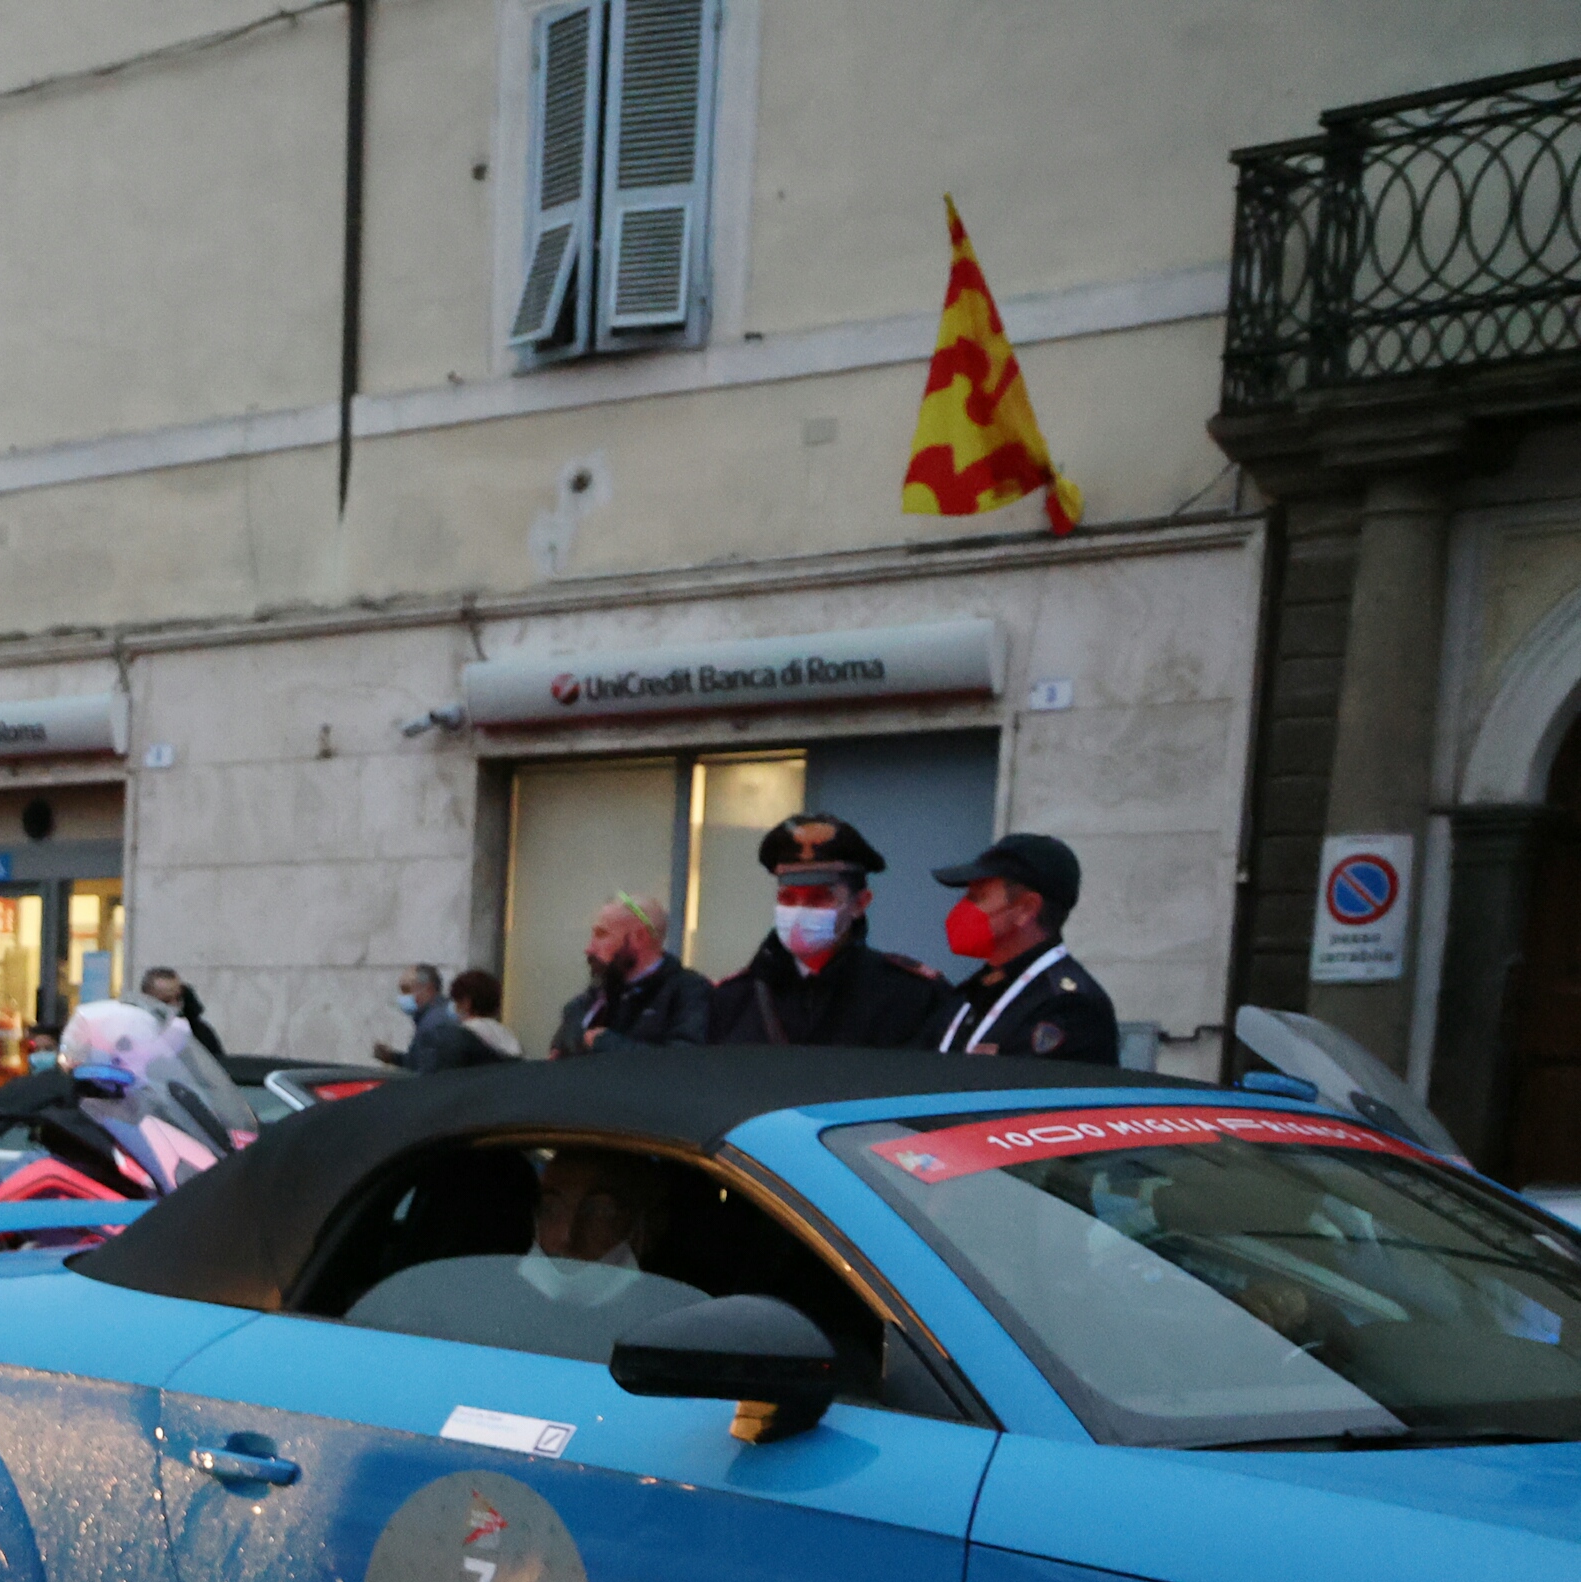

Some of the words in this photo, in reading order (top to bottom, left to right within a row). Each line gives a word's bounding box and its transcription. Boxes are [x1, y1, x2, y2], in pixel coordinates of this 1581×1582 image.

[584, 668, 692, 701] UniCredit
[699, 664, 776, 693] Banca
[780, 657, 803, 686] di
[806, 656, 885, 685] Roma
[987, 1121, 1107, 1150] 1000
[1106, 1117, 1222, 1136] MIGLIA
